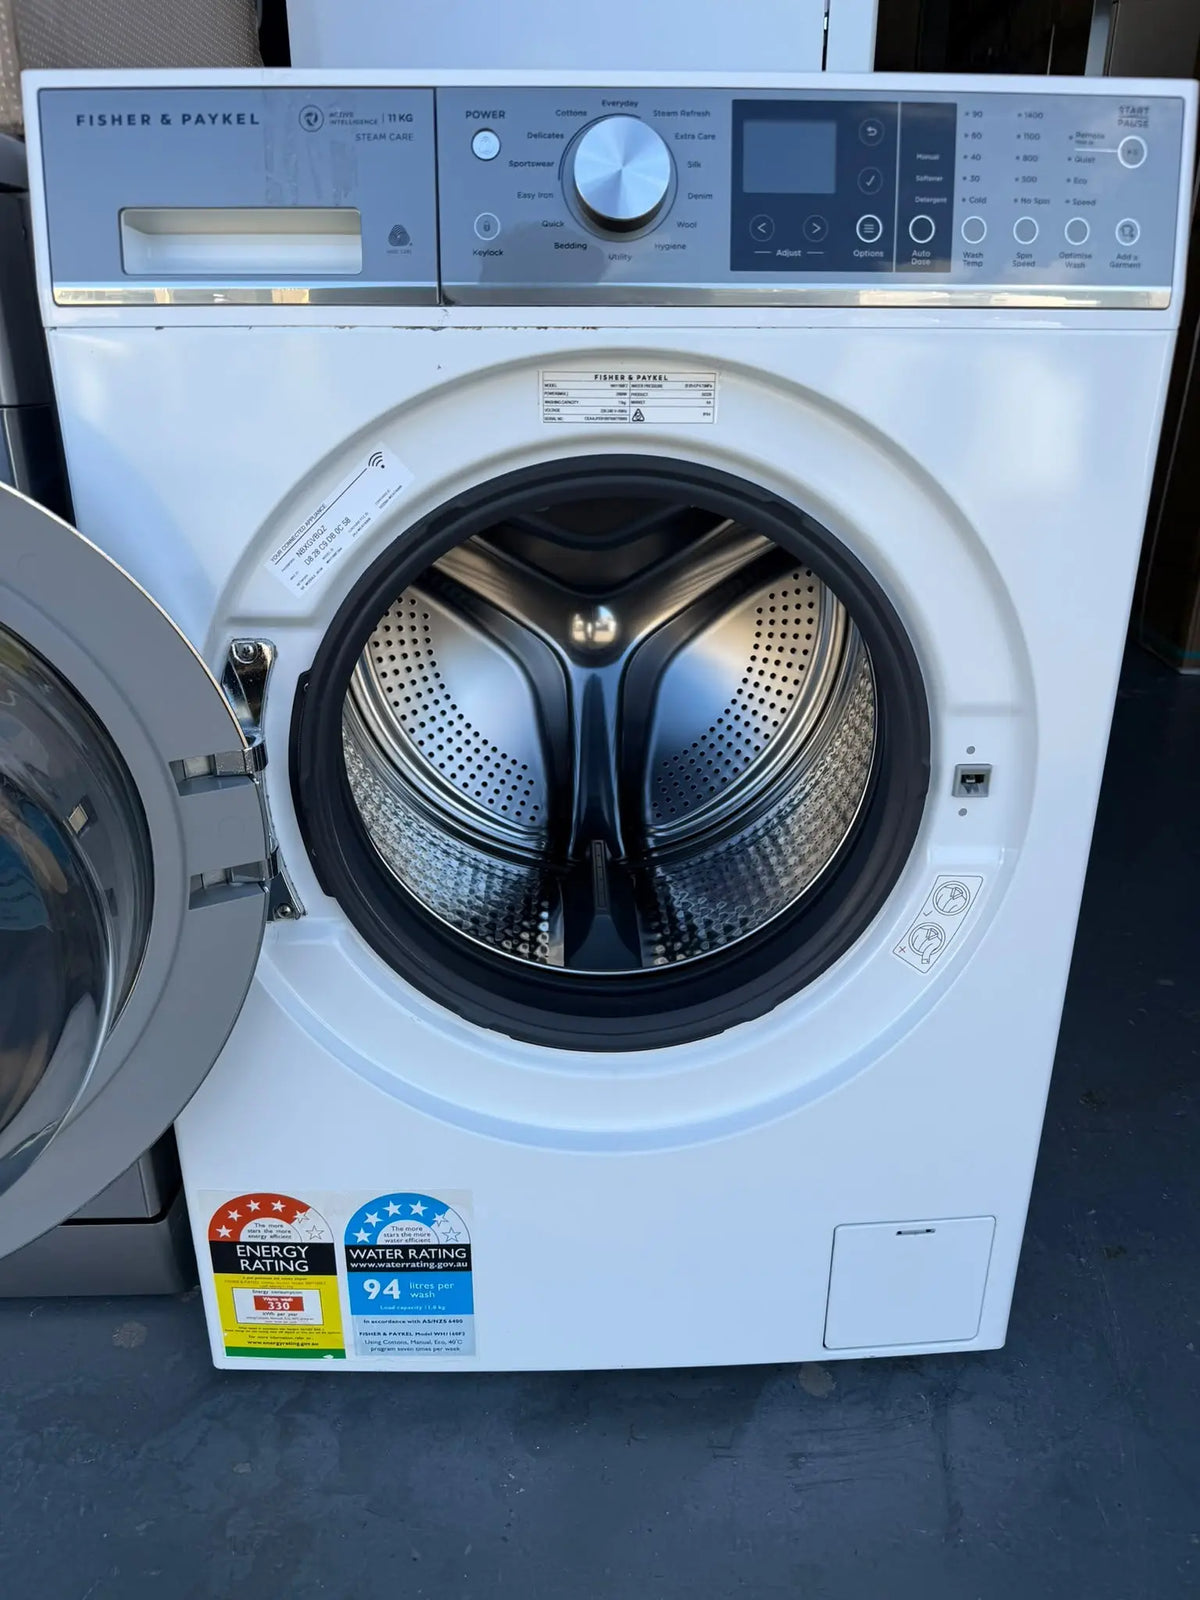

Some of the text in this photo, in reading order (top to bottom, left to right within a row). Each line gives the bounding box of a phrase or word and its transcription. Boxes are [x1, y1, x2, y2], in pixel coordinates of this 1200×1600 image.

[602, 100, 638, 108] Everyday
[1119, 106, 1149, 114] START
[388, 113, 413, 122] 11 KG
[466, 110, 506, 119] POWER
[76, 113, 260, 126] FISHER & PAYKEL
[1118, 120, 1148, 128] PAUSE
[355, 133, 414, 141] STEAM CARE
[509, 160, 554, 168] Sportswear
[517, 192, 534, 200] Easy
[1072, 198, 1096, 206] Speed
[554, 242, 588, 250] Bedding
[654, 243, 686, 251] Hygiene
[473, 249, 503, 257] Keylock
[853, 250, 884, 258] Options
[1016, 252, 1032, 260] Spin
[911, 258, 931, 266] Dose
[963, 260, 983, 268] Temp
[1012, 260, 1036, 268] Speed
[1109, 261, 1141, 269] Garment
[271, 550, 283, 562] YOUR
[280, 524, 306, 551] CONNECTED
[303, 503, 326, 526] APPLIANCE
[236, 1245, 309, 1258] ENERGY
[349, 1248, 466, 1259] WATER RATING
[240, 1259, 309, 1272] RATING
[350, 1261, 468, 1269] www.waterrating.gov.au
[363, 1279, 400, 1299] 94
[267, 1302, 290, 1310] 330
